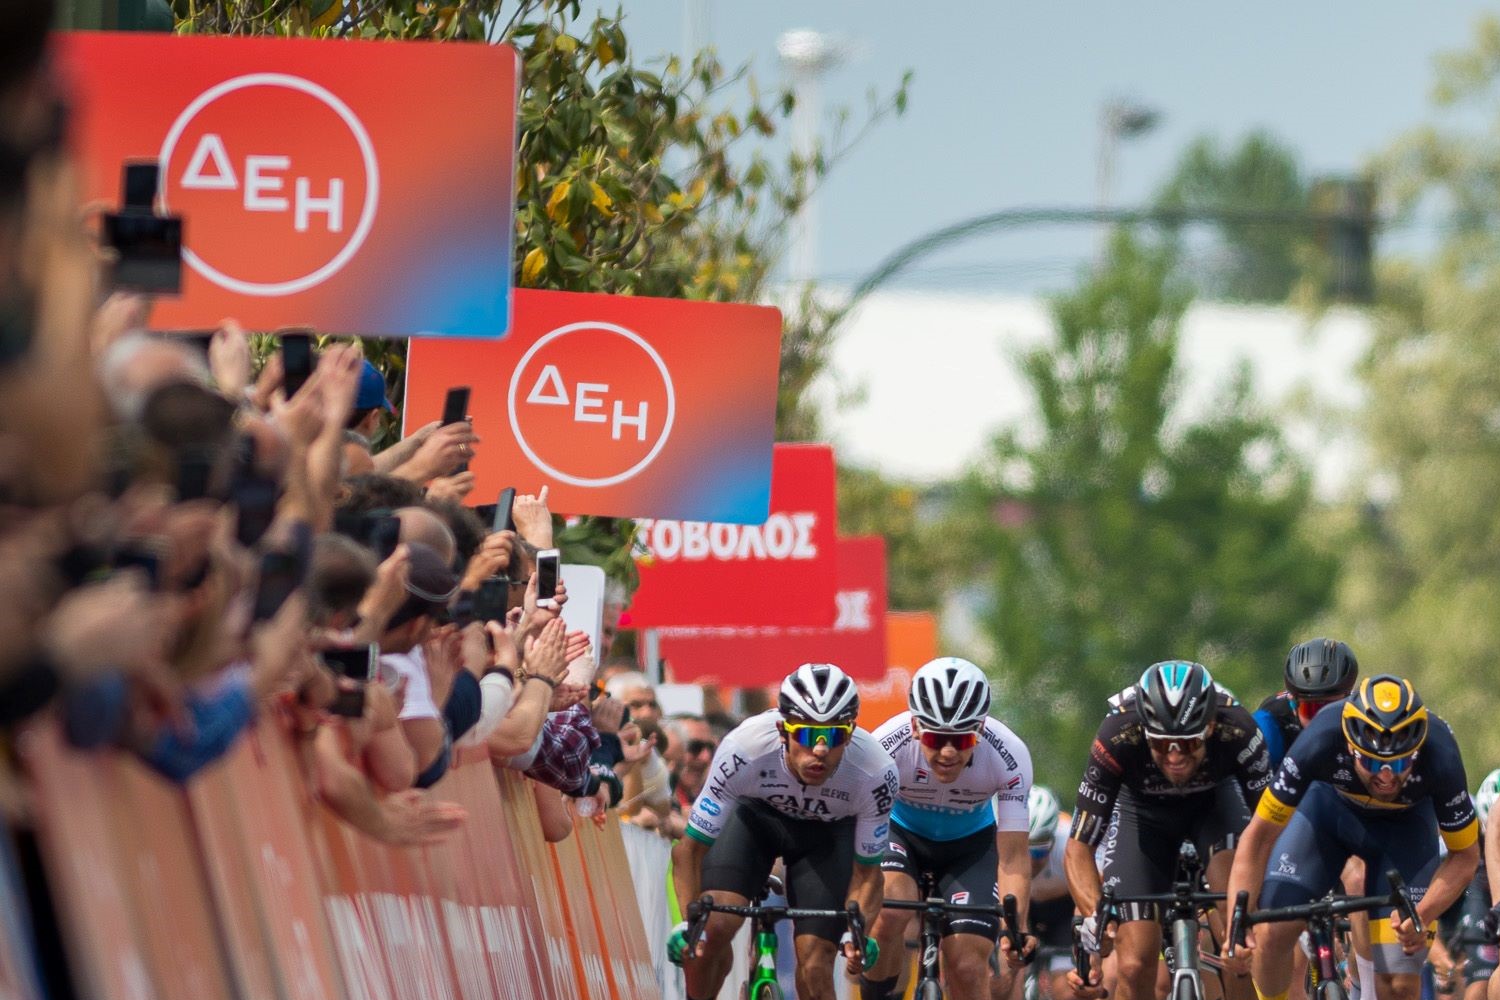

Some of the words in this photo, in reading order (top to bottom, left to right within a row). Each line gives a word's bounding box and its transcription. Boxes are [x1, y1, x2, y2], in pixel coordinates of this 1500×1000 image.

[181, 134, 343, 232] ΔΕΗ
[526, 364, 648, 442] ΔΕΗ
[882, 726, 910, 750] BRINKS
[710, 754, 747, 799] ALEA
